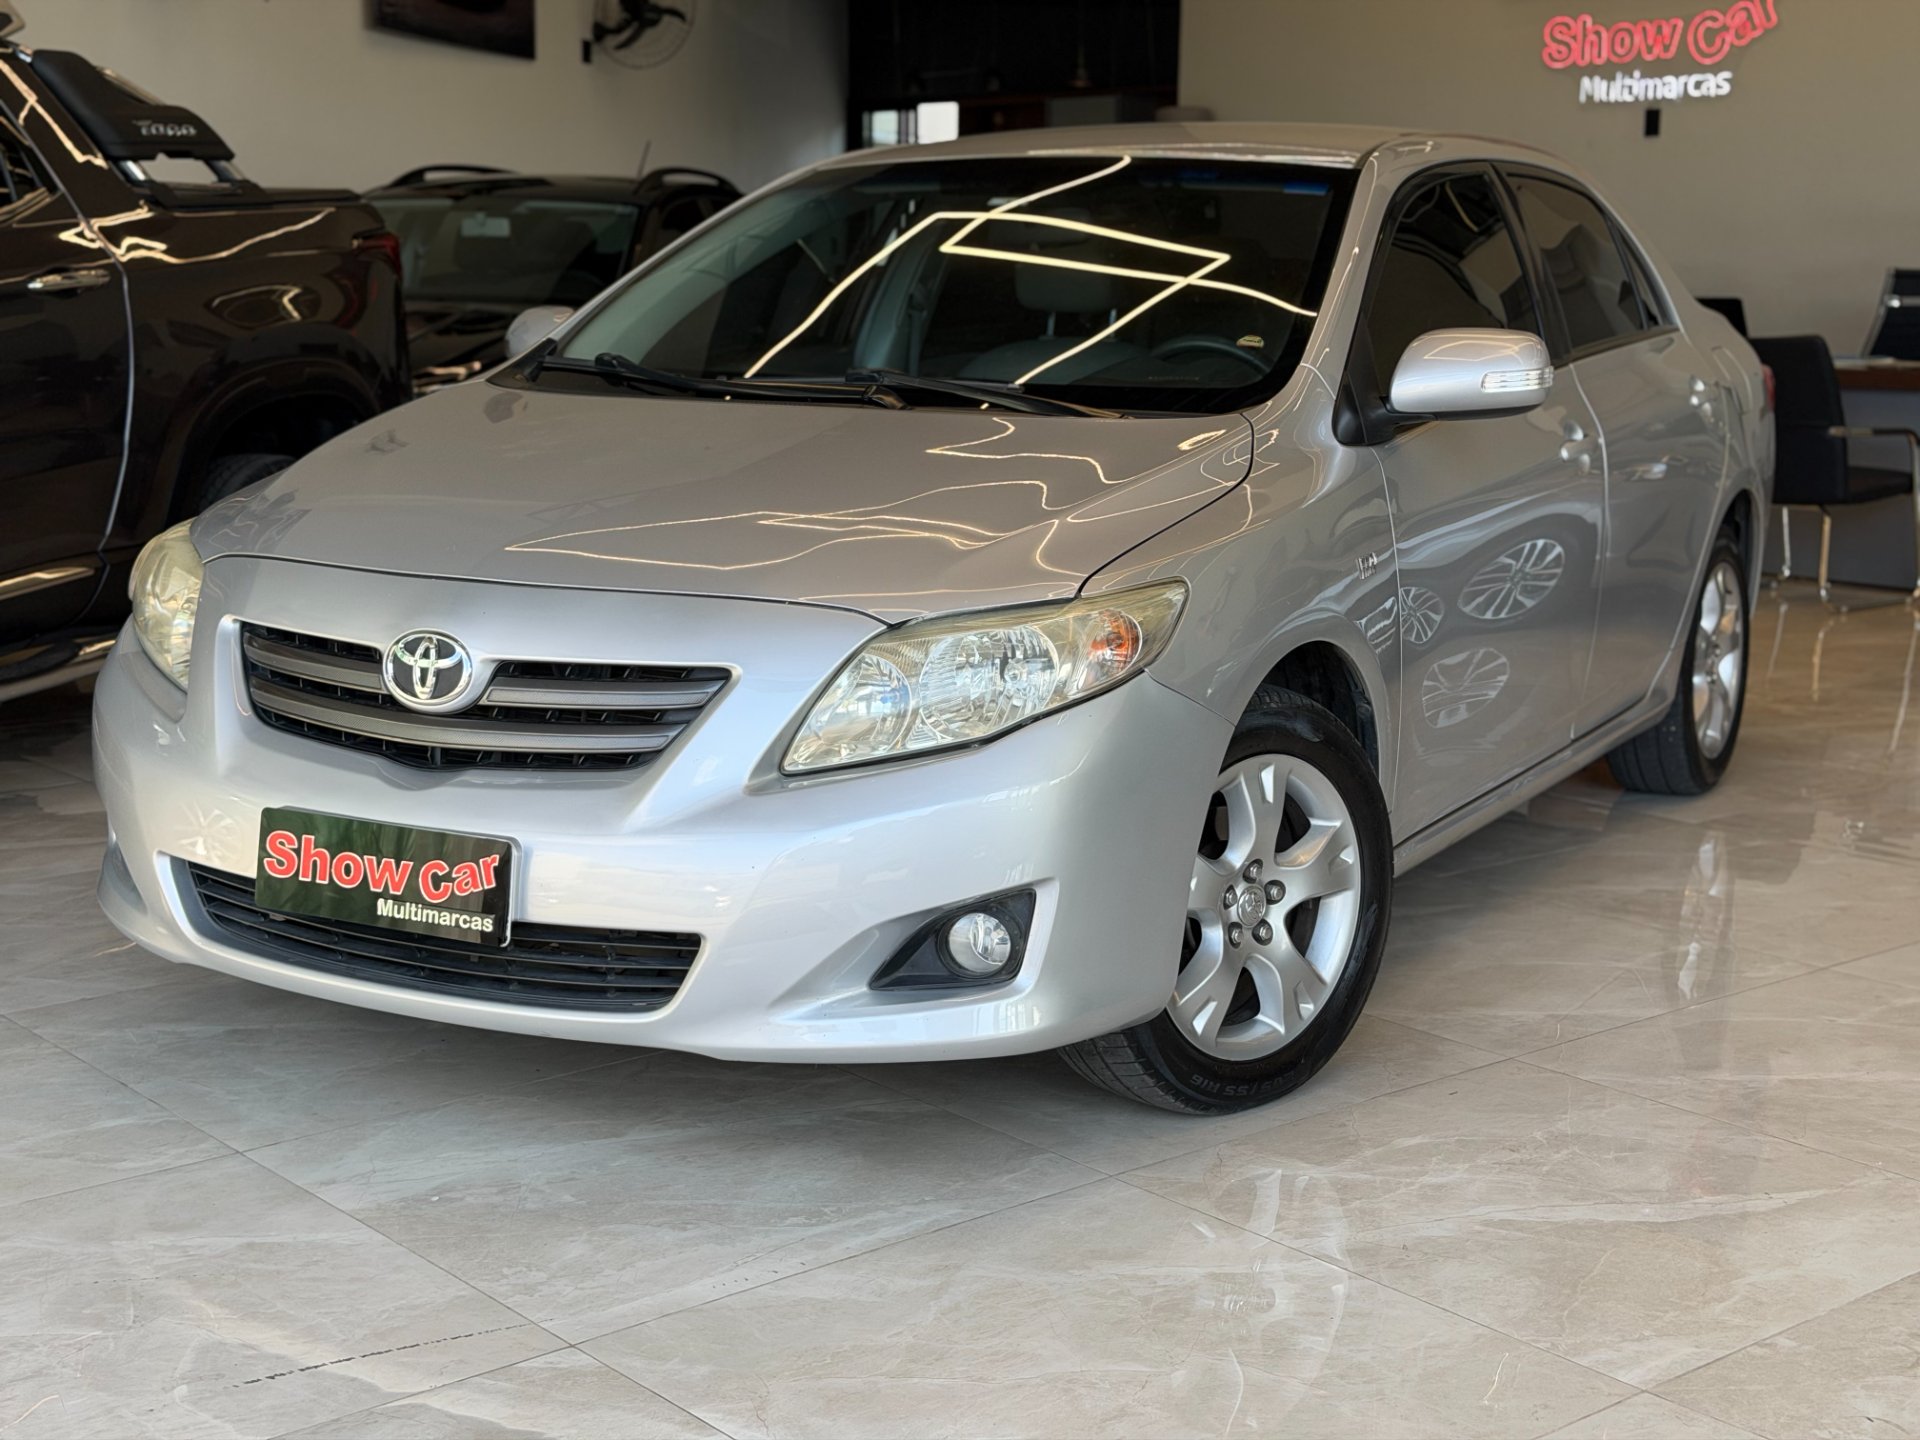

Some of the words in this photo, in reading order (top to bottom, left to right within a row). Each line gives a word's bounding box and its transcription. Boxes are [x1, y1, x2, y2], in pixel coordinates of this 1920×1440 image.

[1542, 13, 1684, 69] Show
[1579, 69, 1733, 103] Multimarcas
[263, 830, 413, 895] Show
[418, 853, 500, 903] Car
[376, 897, 494, 933] Multimarcas
